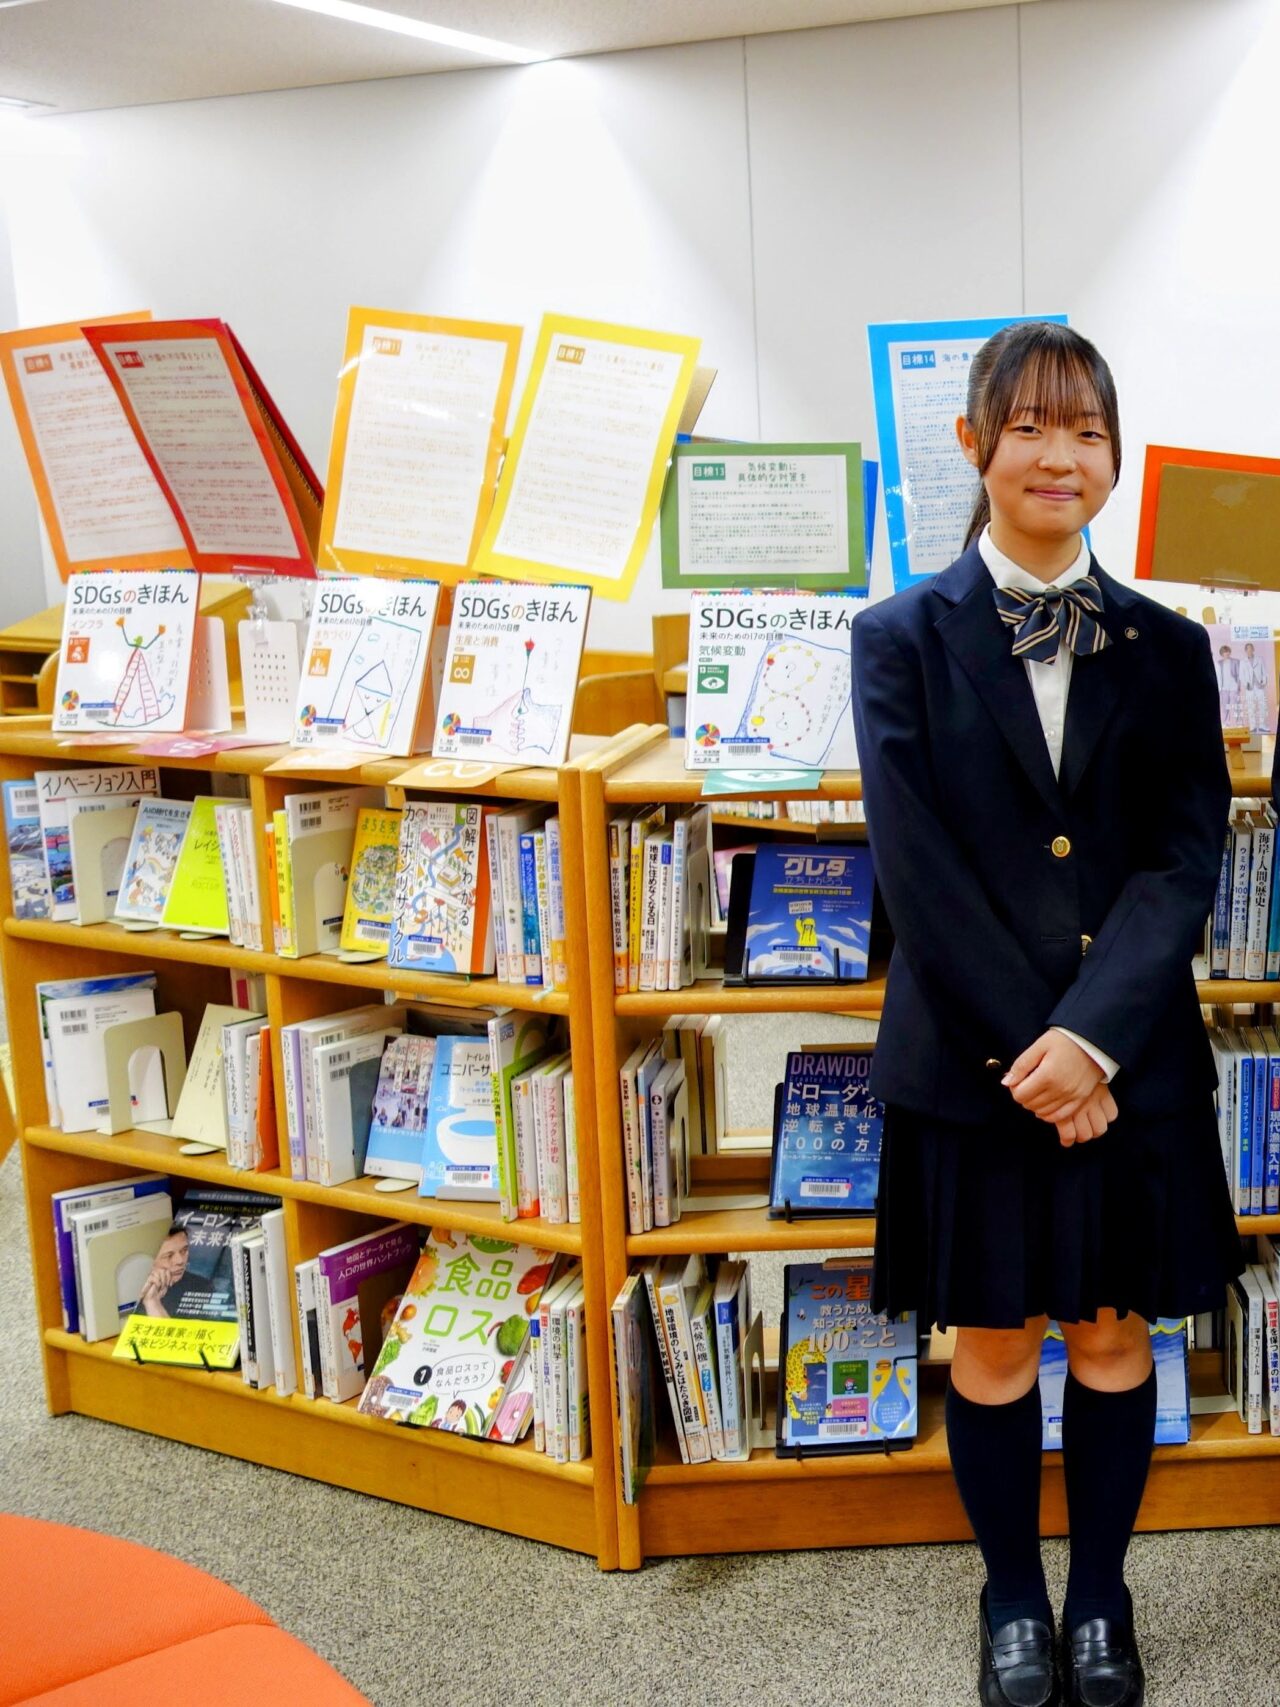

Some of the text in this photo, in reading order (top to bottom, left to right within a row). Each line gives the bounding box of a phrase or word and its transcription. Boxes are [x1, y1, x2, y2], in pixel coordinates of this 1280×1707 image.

[902, 352, 934, 365] 目標14
[693, 466, 725, 477] 目標13
[72, 584, 189, 605] SDGsのきほん
[458, 597, 579, 624] SDGsのきほん
[700, 608, 852, 630] SDGsのきほん
[455, 634, 500, 648] 生産と消費
[699, 631, 784, 641] 未来のための17の目標
[698, 645, 746, 657] 気候変動
[42, 769, 158, 794] イノベーション入門
[461, 806, 478, 927] 図解でわかる
[390, 804, 417, 963] カーボンリサイクル
[790, 1054, 874, 1078] DRAWDO
[784, 1118, 884, 1135] 逆転させ
[783, 1136, 882, 1153] 100の方
[437, 1252, 514, 1301] 食品
[811, 1275, 871, 1302] この星
[424, 1304, 494, 1346] ロス
[813, 1314, 889, 1329] 知っておくべき
[436, 1361, 489, 1377] 食品ロスって
[436, 1373, 486, 1388] なんだろう?
